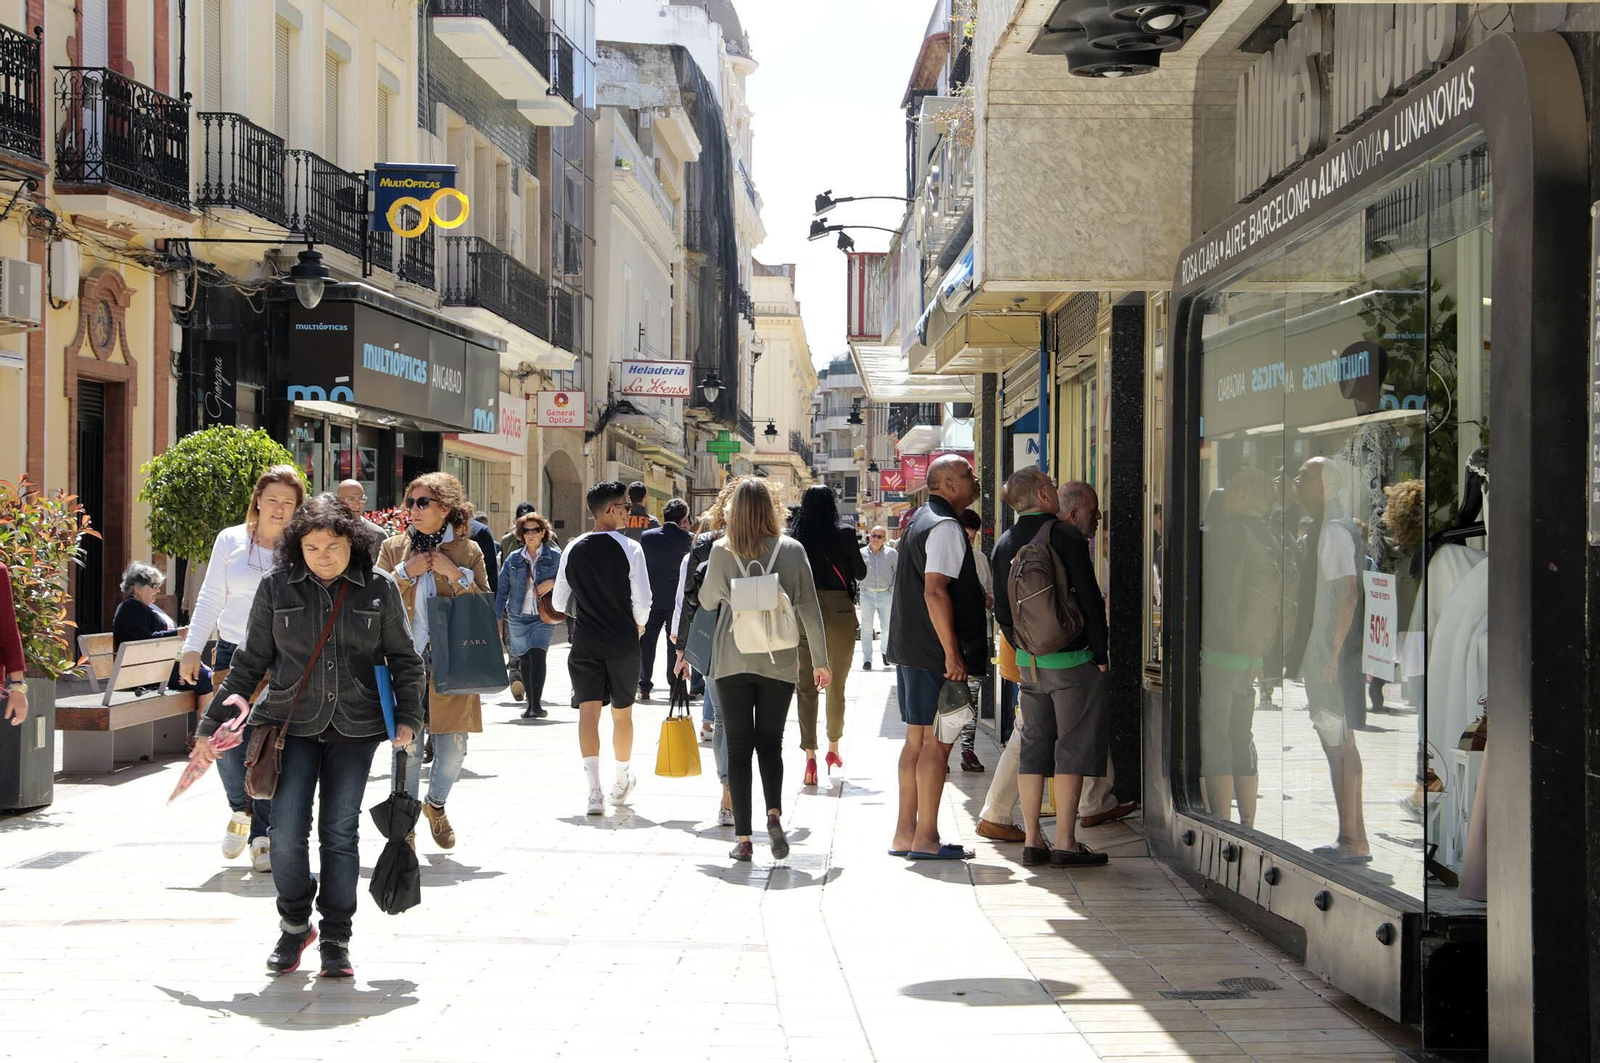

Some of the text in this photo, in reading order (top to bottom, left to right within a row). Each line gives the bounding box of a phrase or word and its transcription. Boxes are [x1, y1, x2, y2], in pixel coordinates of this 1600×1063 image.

[1181, 251, 1198, 287] ROSA
[1199, 238, 1220, 276] CLARA
[1225, 220, 1247, 260] AIRE
[1249, 176, 1310, 246] BARCELONA
[1394, 65, 1475, 151] LUNANOVIAS
[623, 377, 643, 393] La
[546, 409, 576, 417] General
[548, 416, 573, 425] Optica
[626, 515, 651, 528] TAFF
[1370, 613, 1389, 648] 50%
